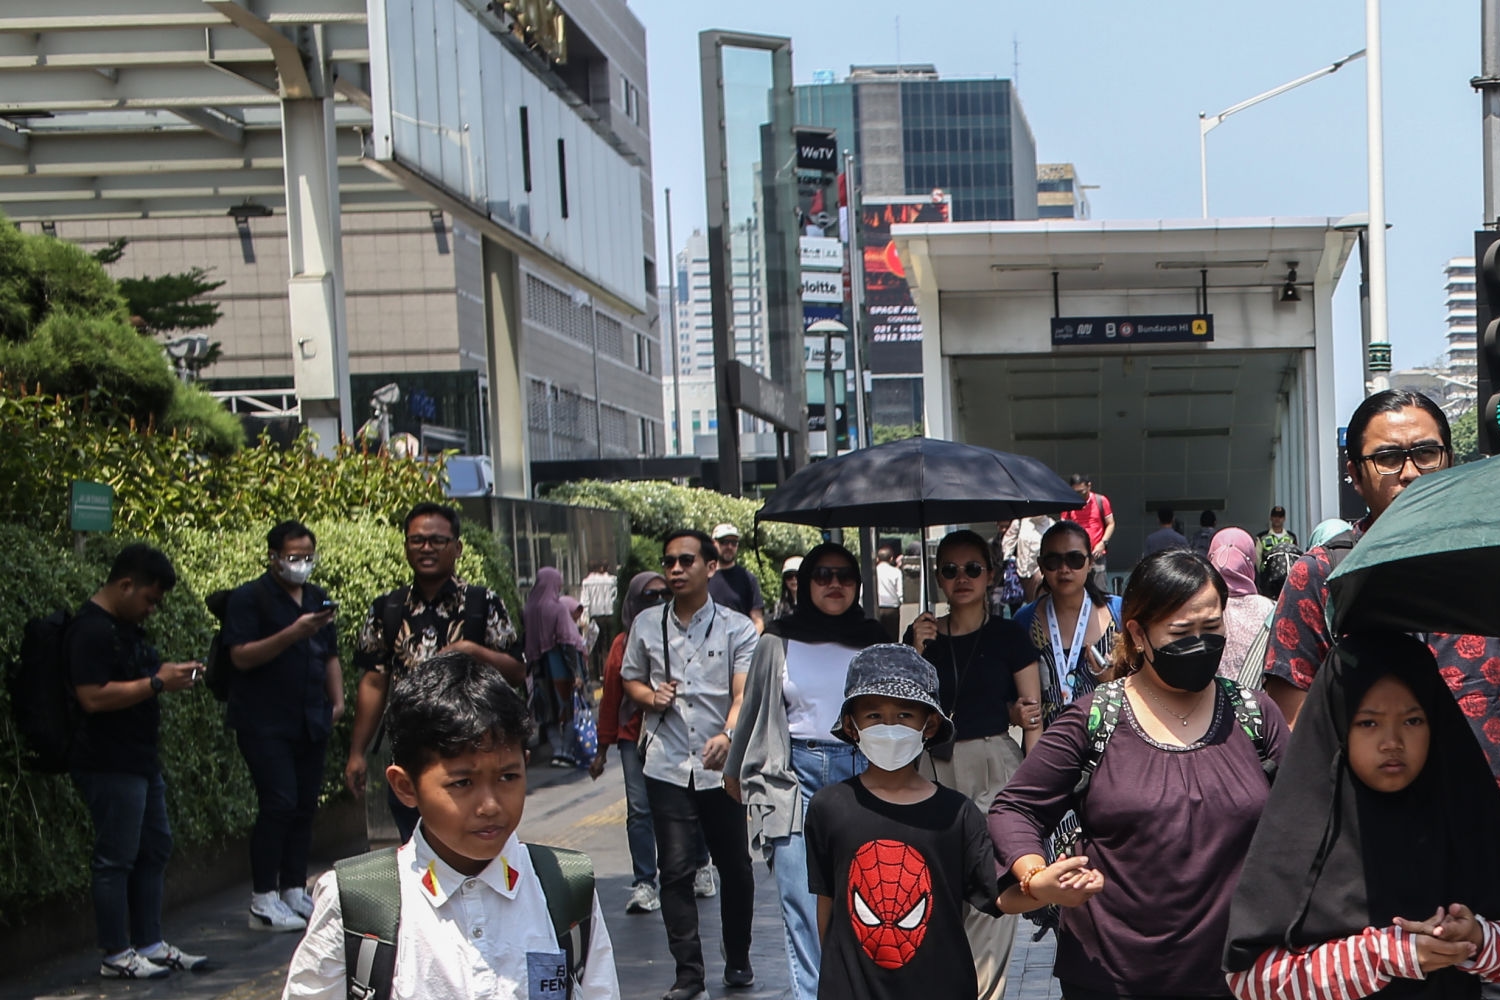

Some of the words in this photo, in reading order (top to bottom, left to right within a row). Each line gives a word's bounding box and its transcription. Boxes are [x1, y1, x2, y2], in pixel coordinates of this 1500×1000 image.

[801, 146, 834, 160] WeTV
[870, 305, 901, 315] SPACE
[1137, 324, 1177, 333] Bundaran
